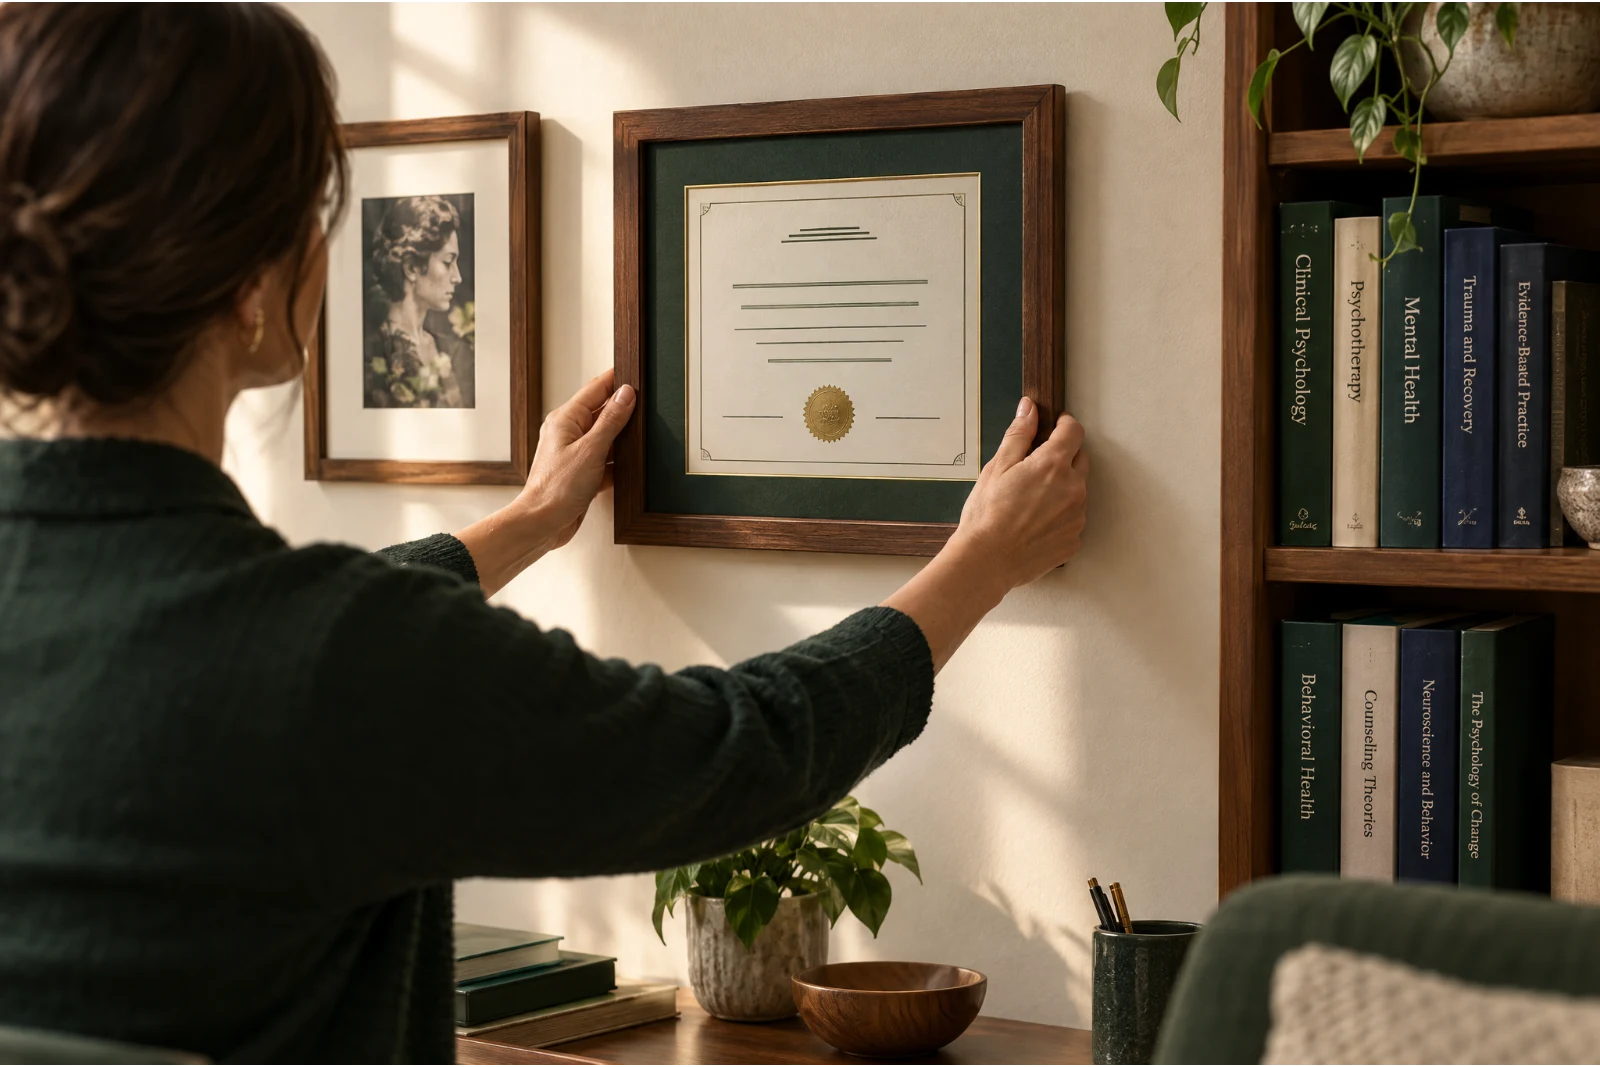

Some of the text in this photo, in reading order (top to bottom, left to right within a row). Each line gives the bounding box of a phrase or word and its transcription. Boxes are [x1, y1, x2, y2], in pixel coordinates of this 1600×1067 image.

[1290, 253, 1312, 426] Clinical Psychology
[1347, 280, 1365, 404] Psychotherapy
[1404, 296, 1421, 425] Mental Health
[1460, 275, 1477, 435] Trauma and Recovery
[1517, 391, 1531, 448] Practice
[1300, 673, 1317, 820] Behavioral Health
[1361, 689, 1378, 838] Counseling Theories
[1419, 679, 1436, 860] Neuroscience and Behavior
[1468, 691, 1484, 859] The Psychology of Change
